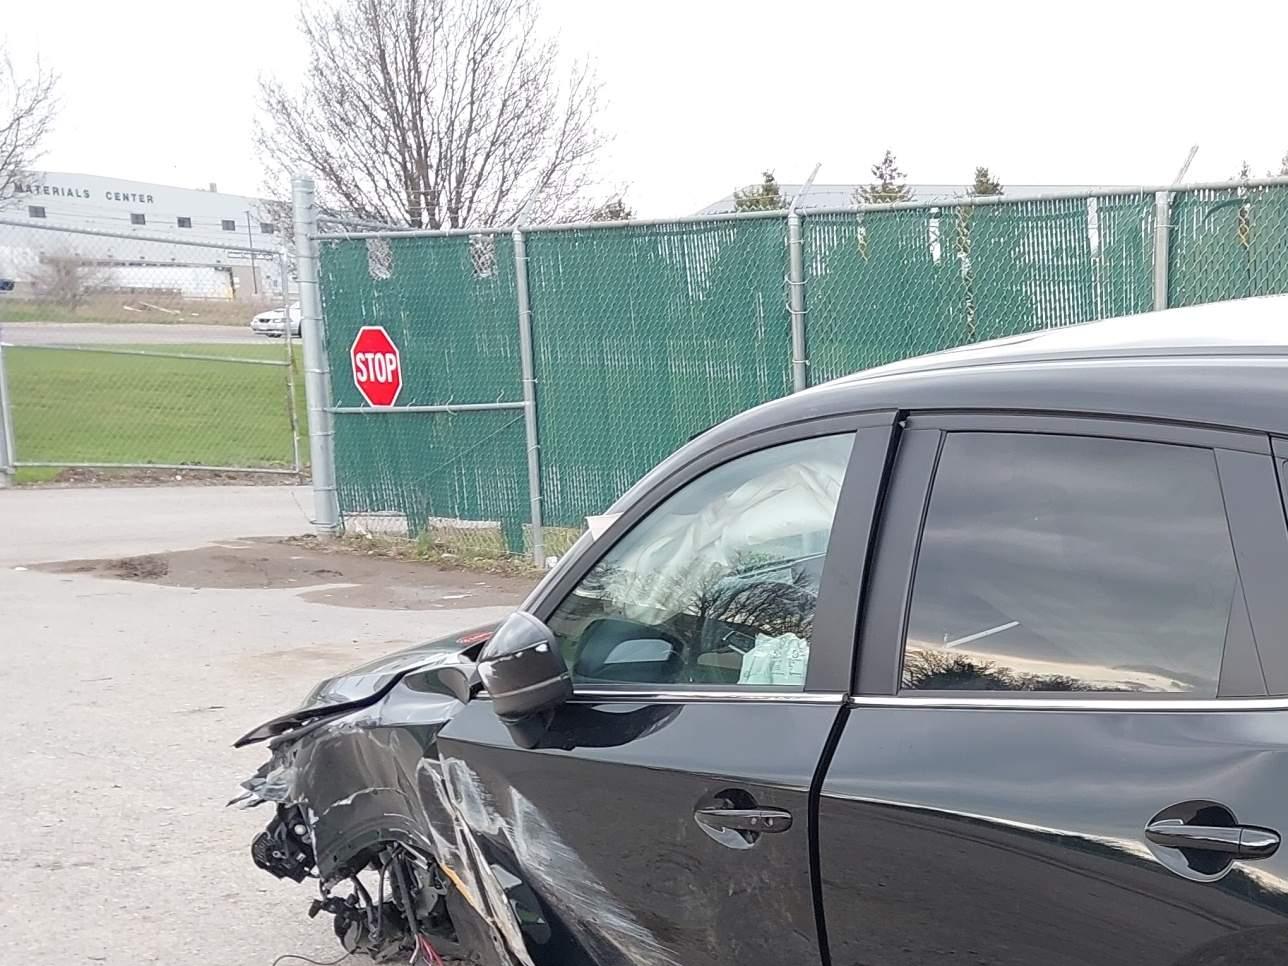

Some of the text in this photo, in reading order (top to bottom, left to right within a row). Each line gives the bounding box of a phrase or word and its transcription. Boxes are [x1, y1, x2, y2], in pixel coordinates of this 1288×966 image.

[14, 183, 155, 204] MATERIALS CENTER
[355, 352, 397, 383] STOP
